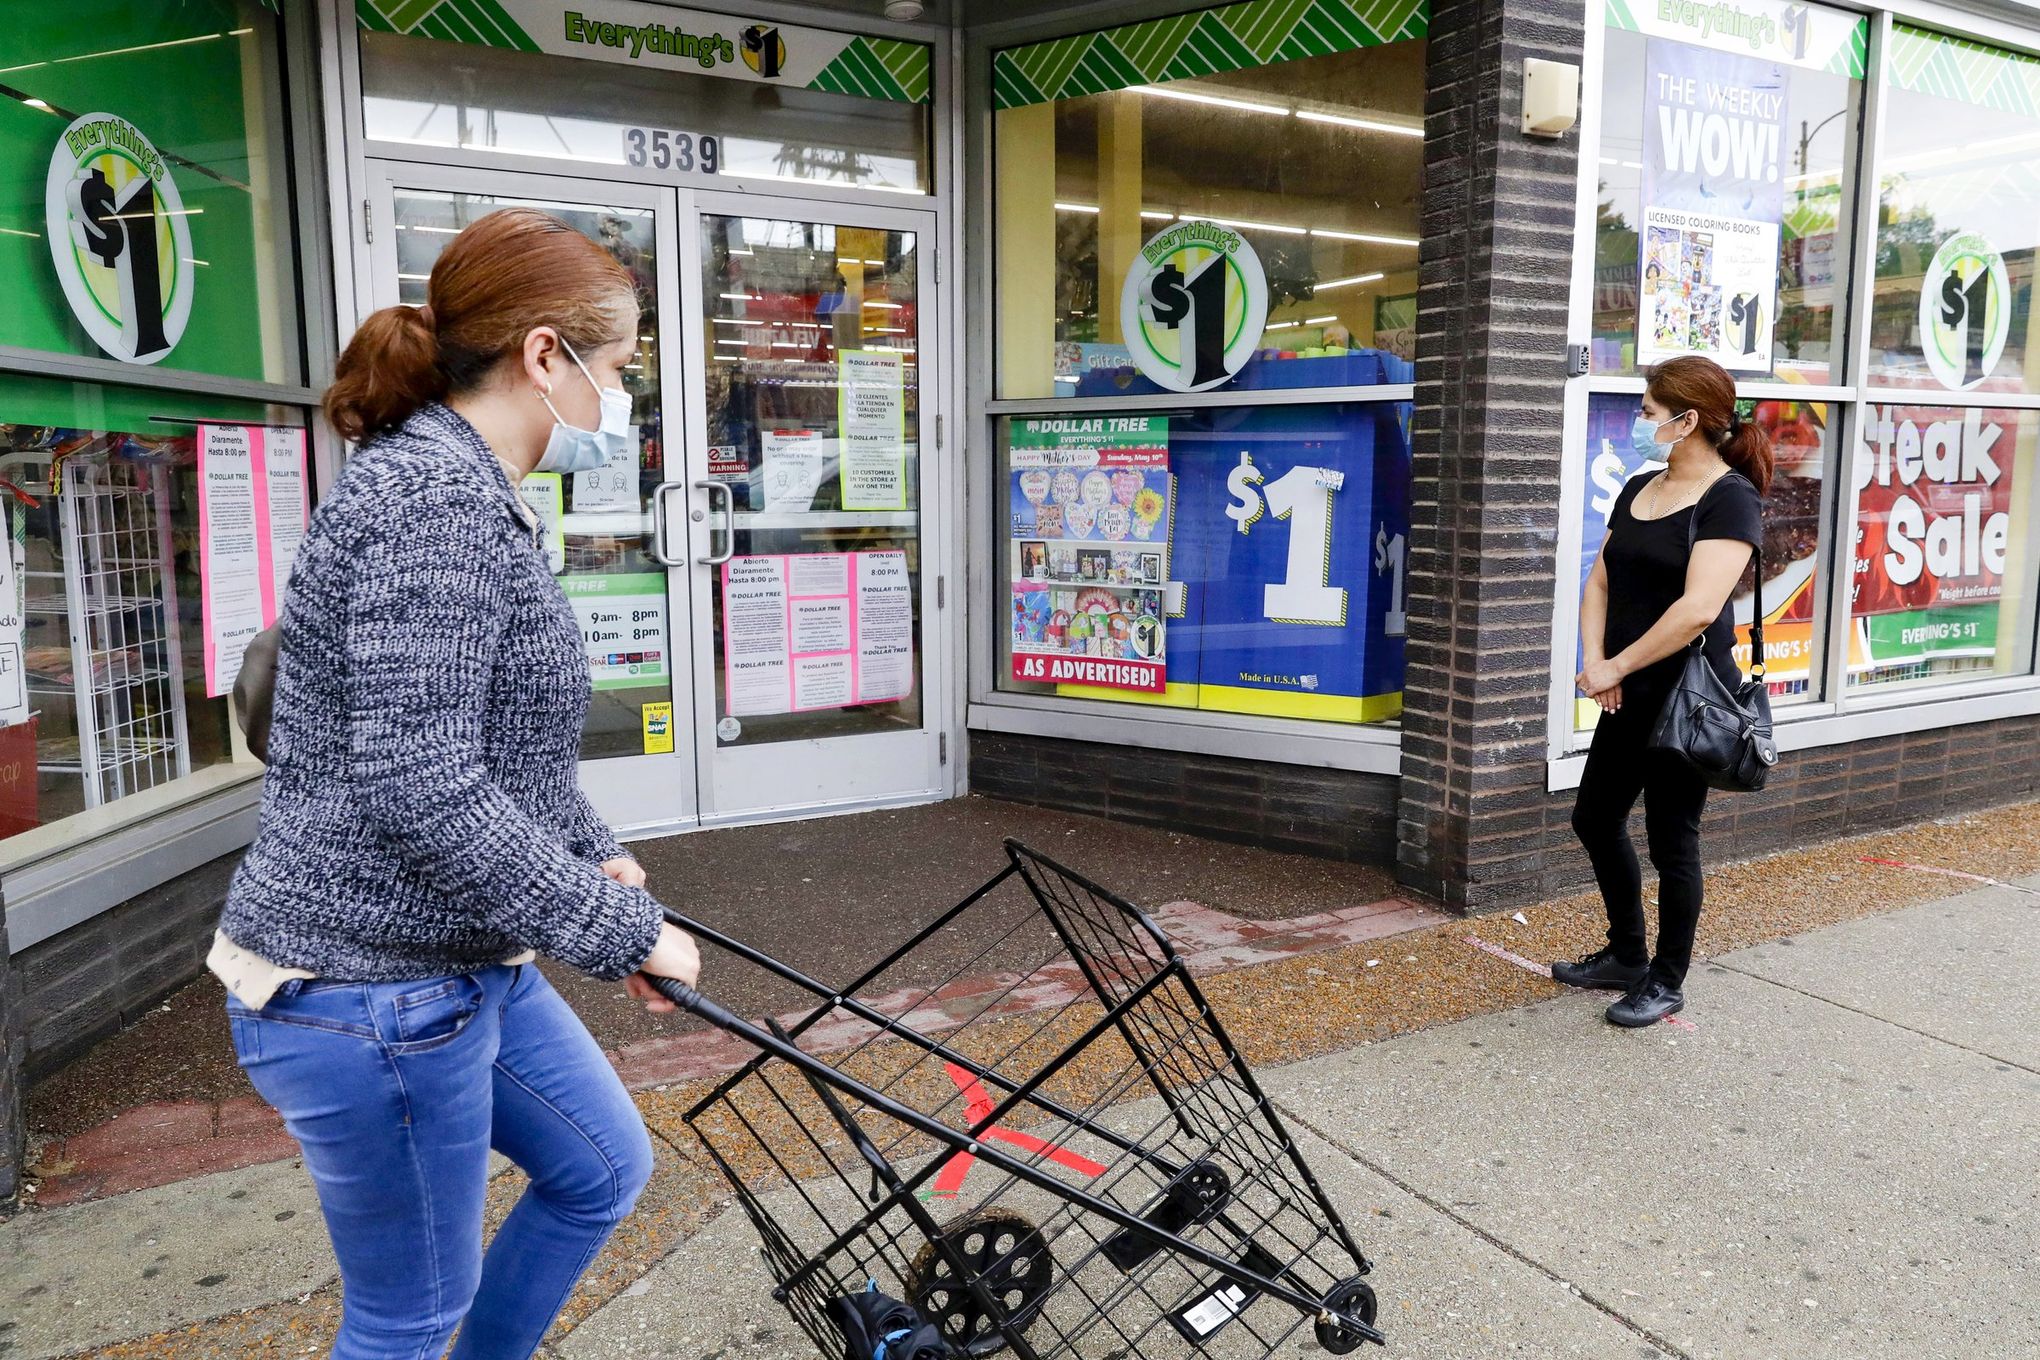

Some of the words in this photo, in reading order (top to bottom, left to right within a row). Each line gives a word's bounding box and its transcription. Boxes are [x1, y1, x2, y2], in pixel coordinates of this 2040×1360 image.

[1658, 0, 1776, 49] Everything's
[1783, 5, 1809, 60] $1
[565, 11, 734, 68] Everything's
[739, 25, 781, 78] $1
[1657, 73, 1696, 105] THE
[1706, 82, 1783, 121] WEEKLY
[65, 119, 164, 182] Everything's
[627, 129, 719, 174] 3539
[1658, 105, 1780, 183] WOW!
[1649, 211, 1686, 226] LICENSED
[1689, 217, 1731, 232] COLORING
[1733, 223, 1761, 236] BOOKS
[1142, 221, 1241, 264] Everything's
[66, 167, 172, 358] $1
[1140, 252, 1231, 387] $1
[1729, 293, 1760, 356] $1
[1941, 265, 1988, 387] $1
[854, 359, 879, 367] DOLLAR
[1088, 353, 1110, 368] Gift
[1758, 353, 1766, 361] EA
[1041, 419, 1103, 434] DOLLAR
[1108, 417, 1149, 433] TREE
[211, 435, 243, 445] Diaramente
[1060, 435, 1107, 443] EVERYTHING'S
[208, 448, 224, 456] Hasta
[238, 450, 247, 458] pm
[1041, 451, 1075, 464] Mother's
[1107, 454, 1133, 462] Sunday,
[1134, 454, 1150, 462] May
[709, 464, 747, 472] WARNING
[214, 473, 234, 481] DOLLAR
[1225, 451, 1347, 625] $1
[1884, 491, 2010, 586] Sale
[733, 567, 774, 575] Diaramente
[1375, 521, 1406, 636] $1
[567, 580, 608, 593] TREE
[1964, 585, 1989, 598] before
[632, 610, 658, 622] 8pm
[227, 628, 245, 638] DOLLAR
[633, 628, 660, 640] 8pm
[1964, 622, 1976, 638] $1
[1137, 624, 1156, 657] $1
[590, 656, 607, 666] STAR
[740, 661, 767, 669] DOLLAR
[1023, 658, 1045, 677] AS
[1051, 660, 1157, 688] ADVERTISED!
[1239, 672, 1262, 683] Made
[1263, 673, 1271, 683] in
[1273, 675, 1300, 685] U.S.A.
[648, 724, 667, 732] SNAP
